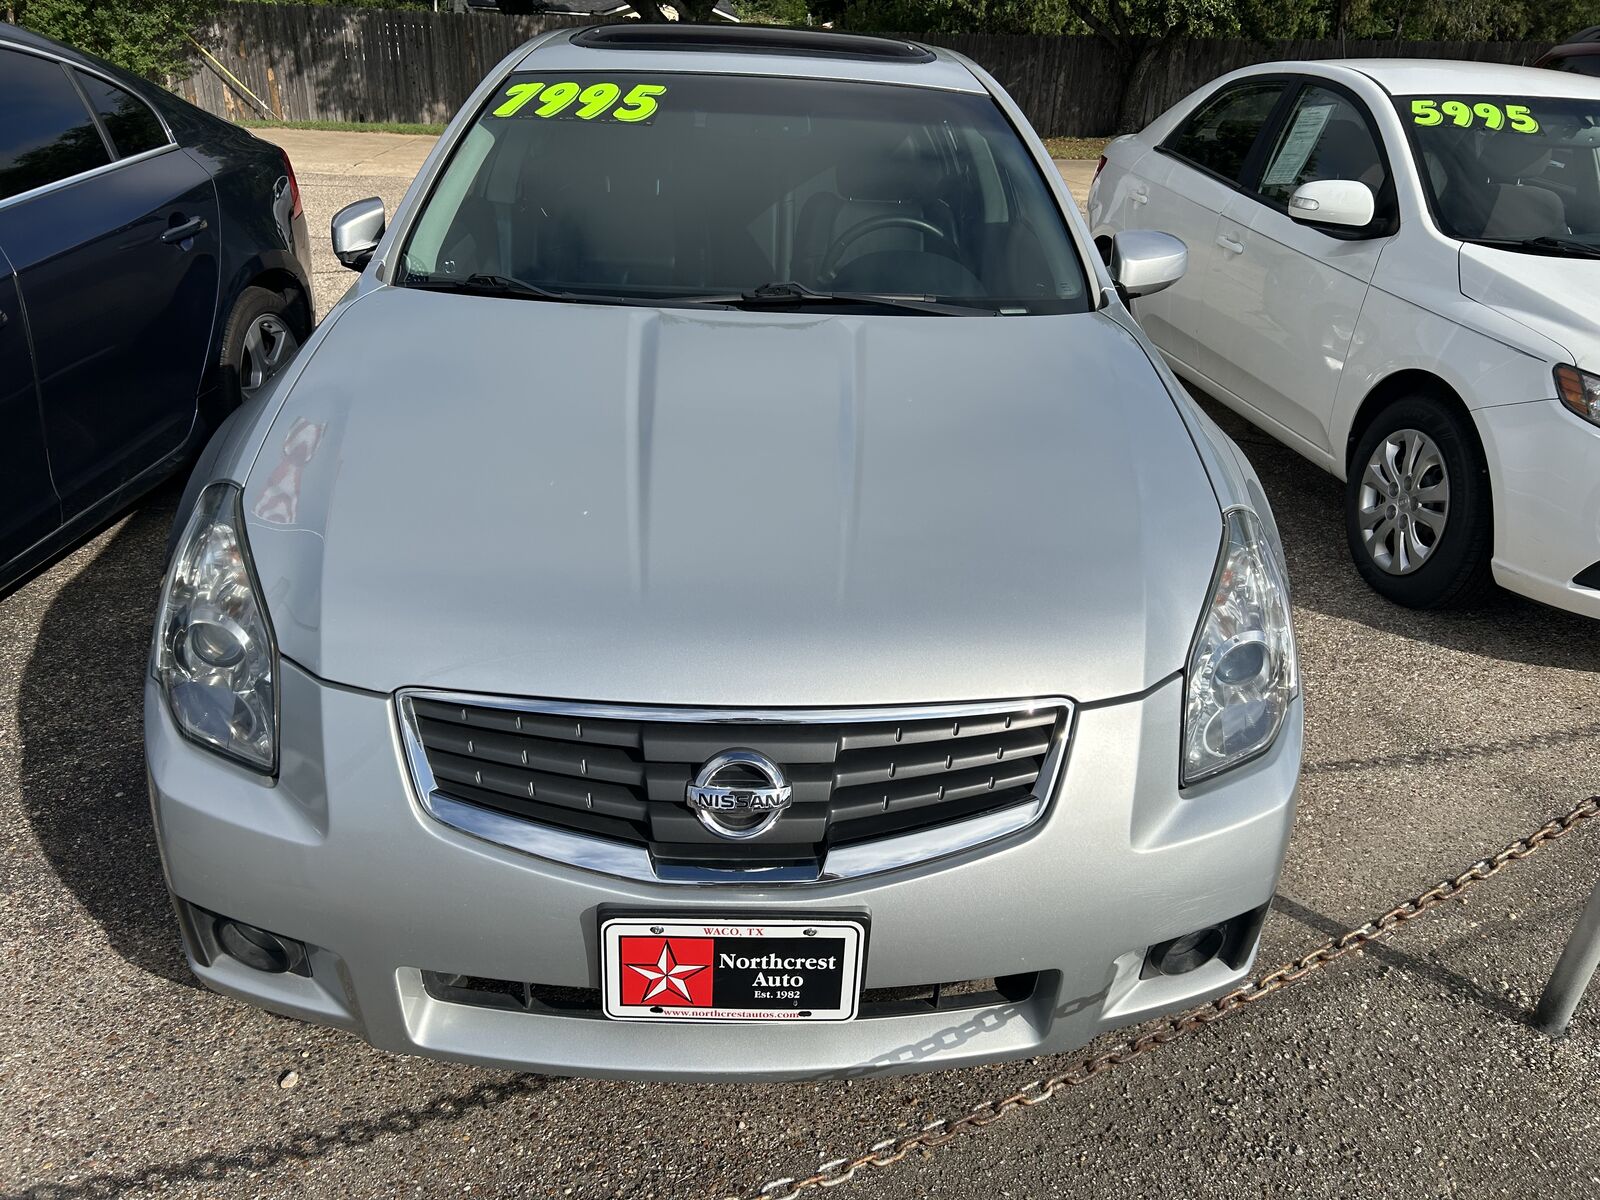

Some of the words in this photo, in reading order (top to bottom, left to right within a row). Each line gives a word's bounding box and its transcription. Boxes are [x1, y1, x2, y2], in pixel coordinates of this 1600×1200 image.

[492, 82, 667, 122] 7995
[1411, 100, 1539, 134] 5995
[698, 793, 780, 808] NISSAN
[703, 927, 742, 936] WACO,
[747, 928, 764, 936] TX
[719, 953, 836, 970] Northcrest
[752, 972, 804, 987] Auto
[754, 990, 774, 999] Est.
[776, 990, 800, 999] 1982
[663, 1009, 800, 1019] www.northcrestautos.com
